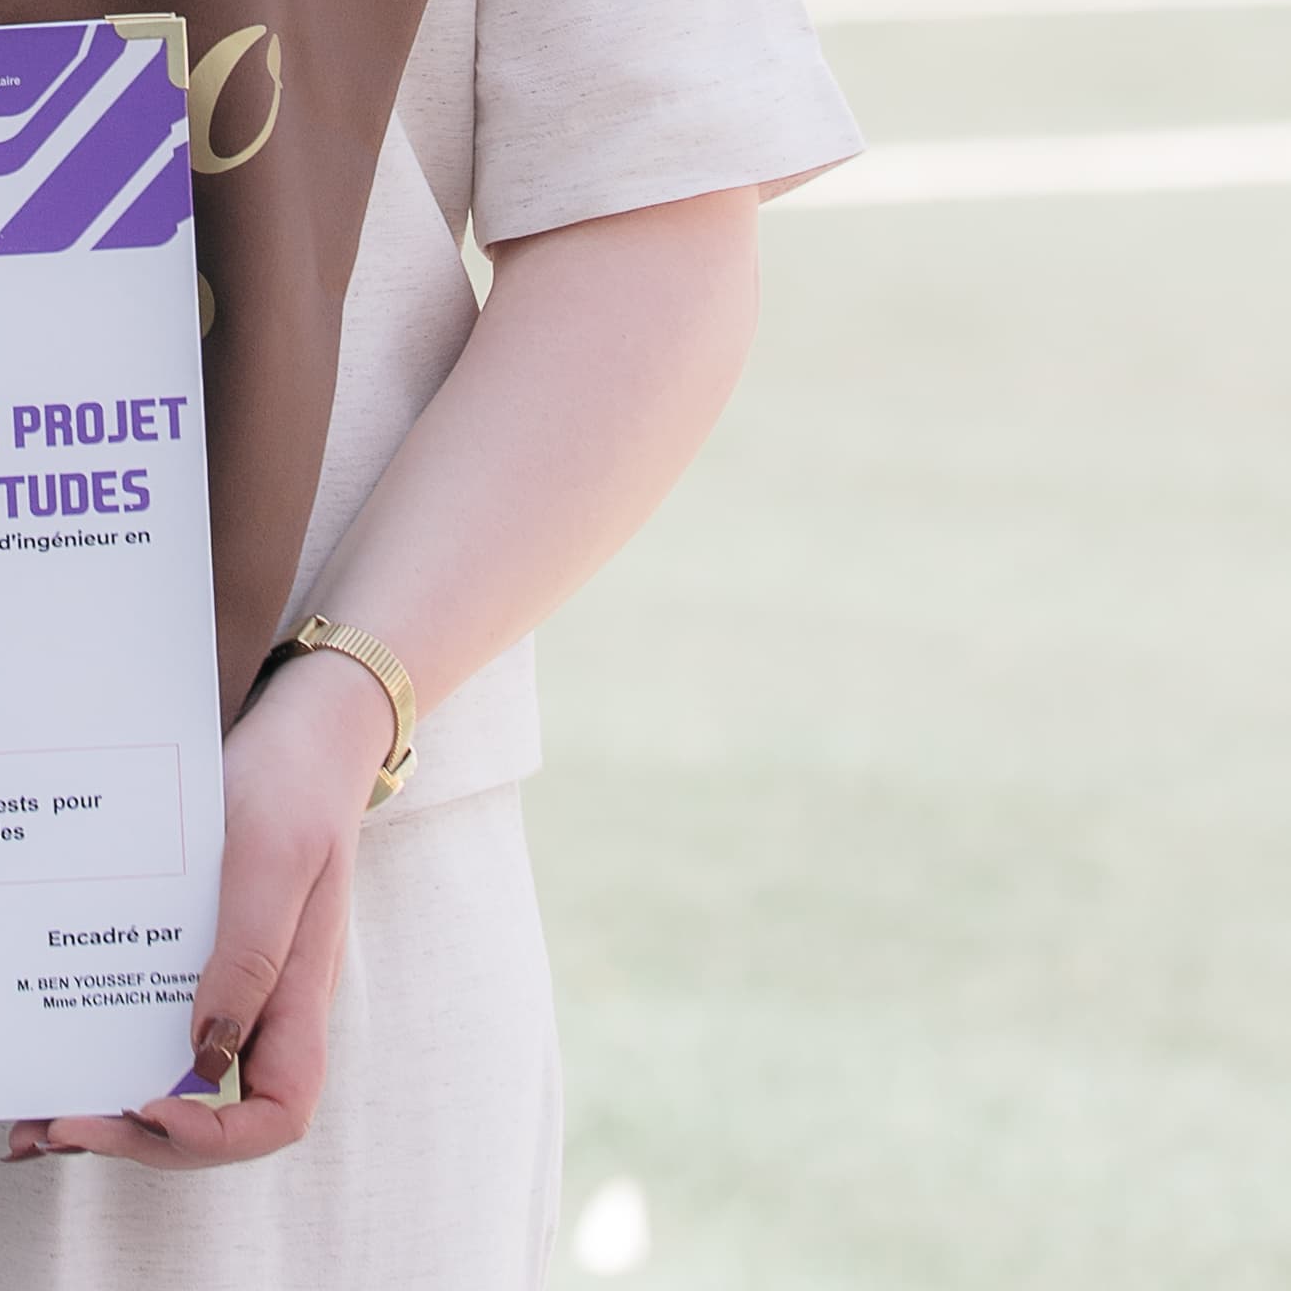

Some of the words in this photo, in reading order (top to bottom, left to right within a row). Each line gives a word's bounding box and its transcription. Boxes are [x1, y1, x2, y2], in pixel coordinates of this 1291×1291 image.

[12, 395, 188, 449] PROJET
[126, 532, 150, 543] en
[53, 795, 103, 815] pour
[48, 926, 139, 947] Encadré
[146, 928, 183, 947] par
[17, 979, 33, 992] M.
[38, 977, 68, 990] BEN
[73, 972, 145, 990] YOUSSEF
[44, 997, 76, 1008] Mme
